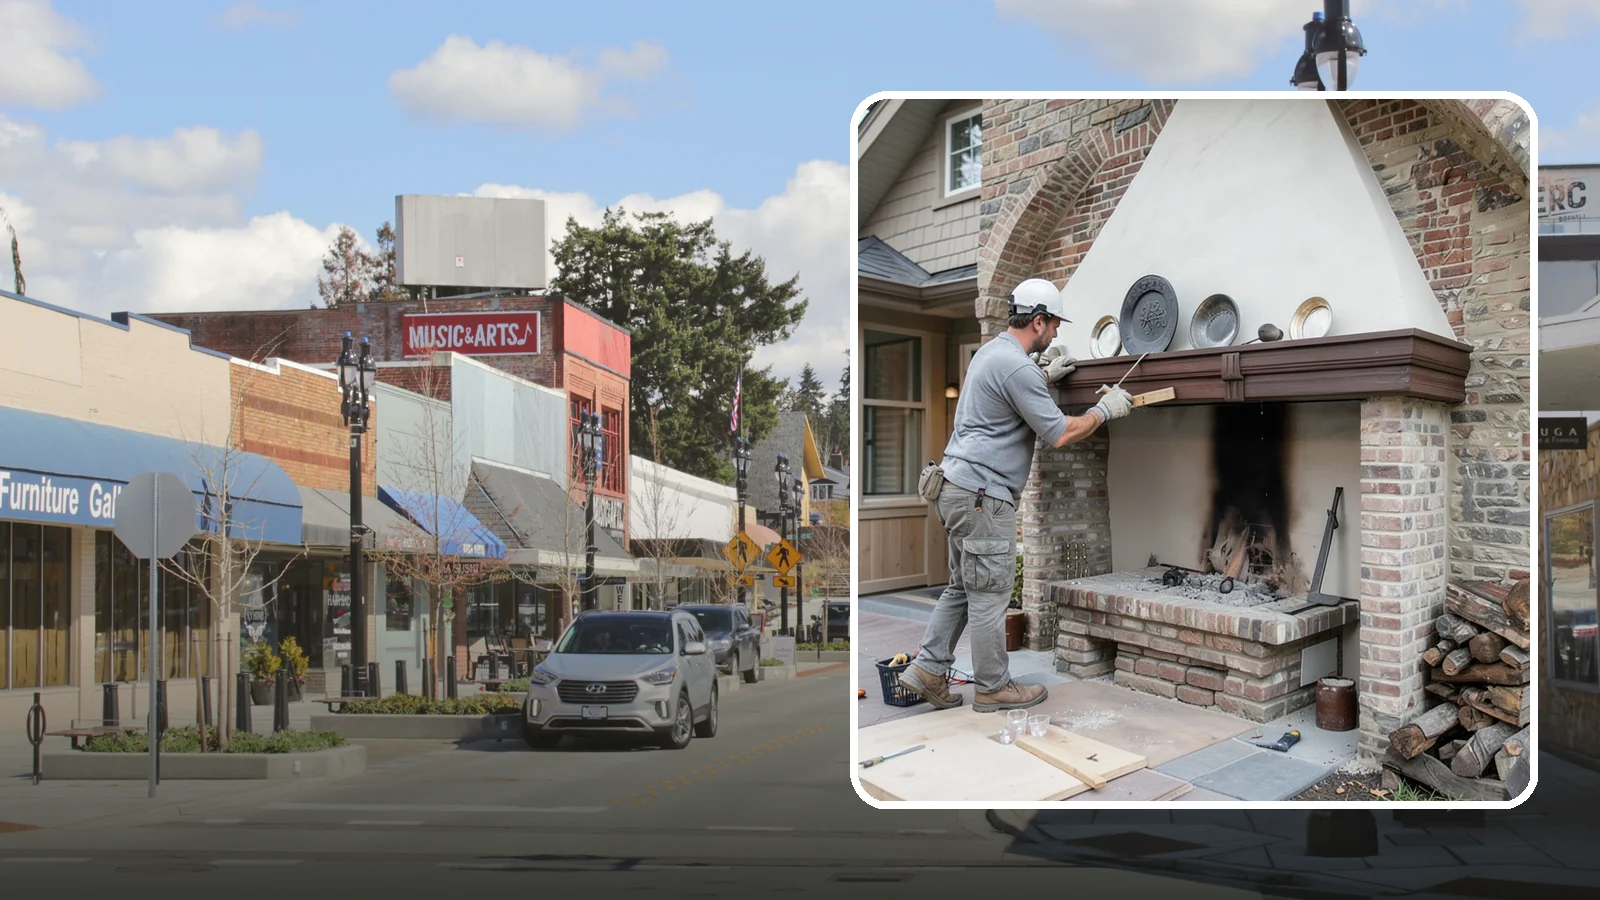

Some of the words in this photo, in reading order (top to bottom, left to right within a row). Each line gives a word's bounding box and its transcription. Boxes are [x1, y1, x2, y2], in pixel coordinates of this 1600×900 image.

[409, 323, 520, 349] MUSIC&ARTS
[1540, 427, 1577, 437] UGA
[0, 471, 79, 515] Furniture
[453, 563, 480, 575] SUSHI
